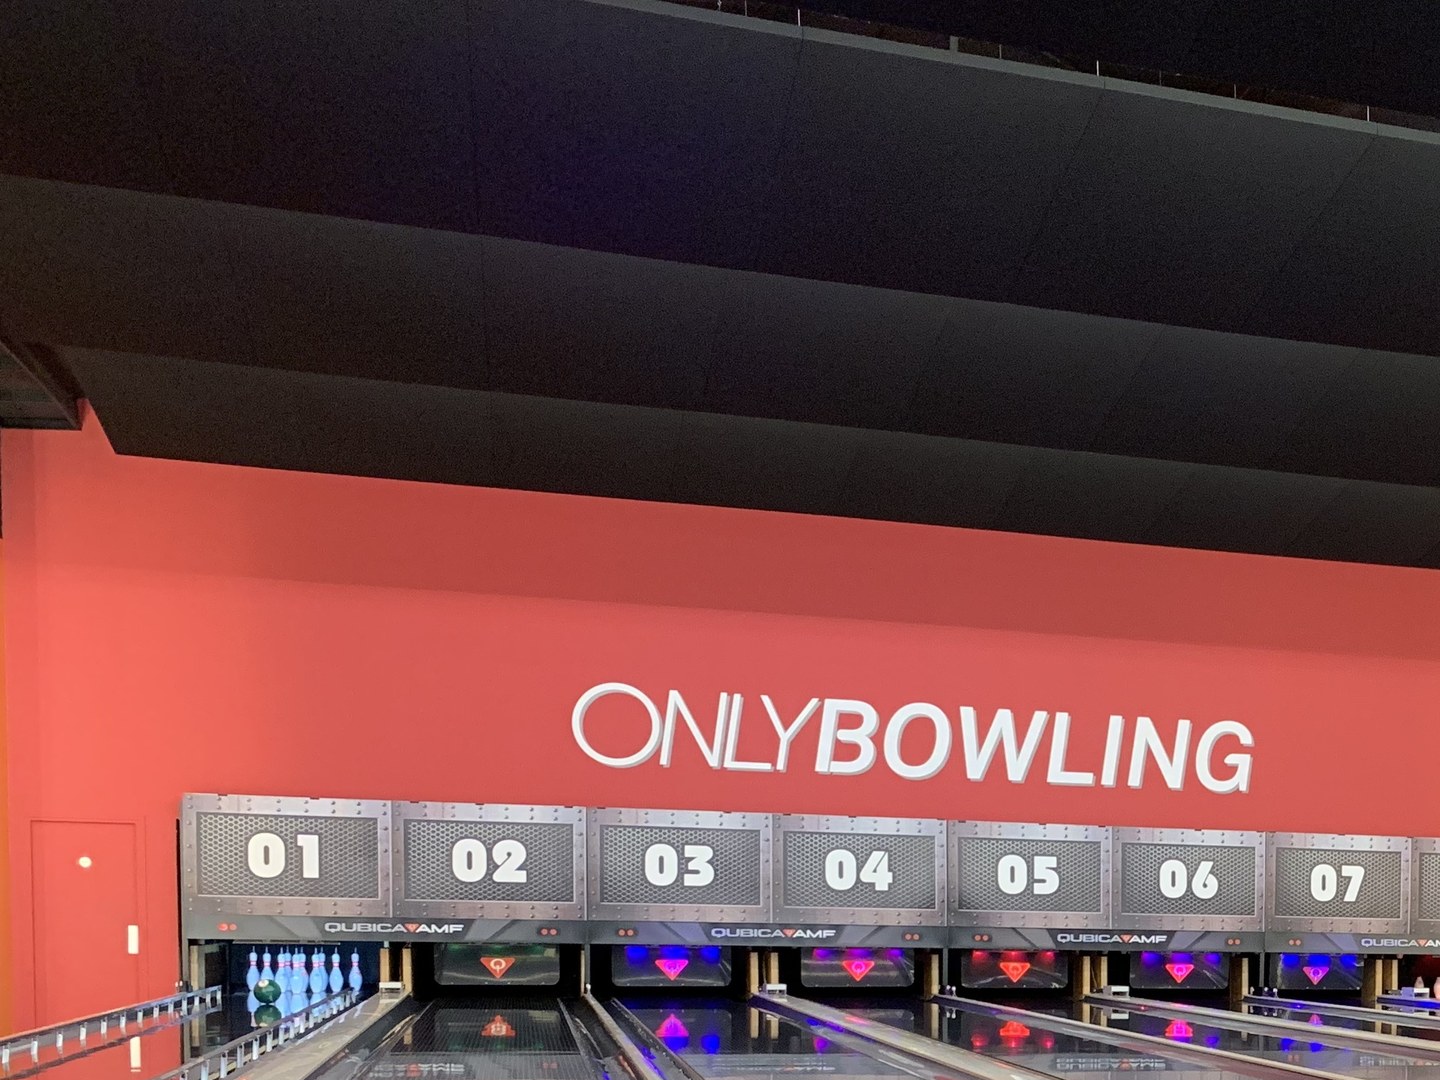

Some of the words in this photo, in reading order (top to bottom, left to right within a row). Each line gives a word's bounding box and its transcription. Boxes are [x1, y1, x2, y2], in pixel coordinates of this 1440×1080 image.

[247, 832, 320, 879] 01
[452, 838, 527, 883] 02
[644, 843, 715, 887] 03
[825, 849, 893, 891] 04
[997, 854, 1060, 895] 05
[1159, 859, 1219, 899] 06
[1310, 863, 1365, 902] 07
